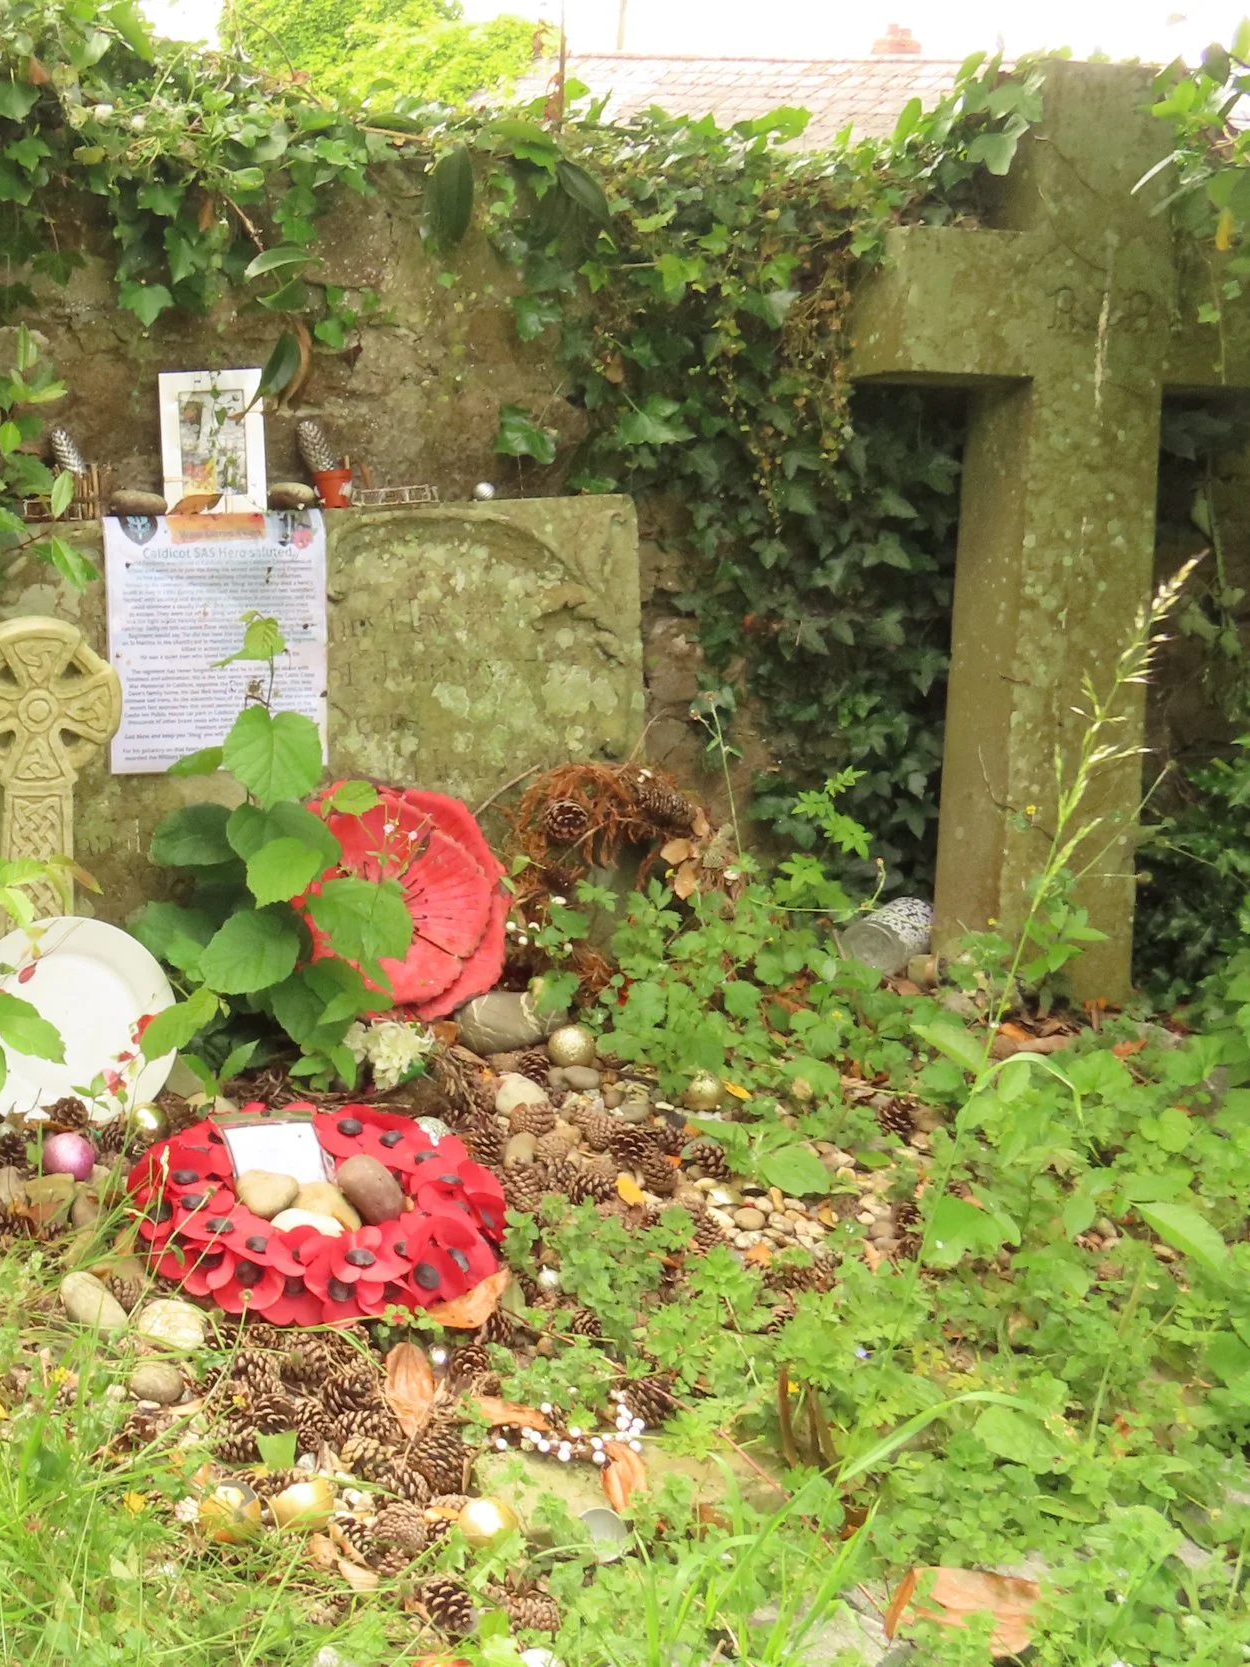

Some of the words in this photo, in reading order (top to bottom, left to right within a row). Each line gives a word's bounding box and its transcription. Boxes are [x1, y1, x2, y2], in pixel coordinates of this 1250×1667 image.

[143, 547, 191, 559] Caldicot
[193, 547, 215, 558] SAS
[218, 547, 245, 558] Hero
